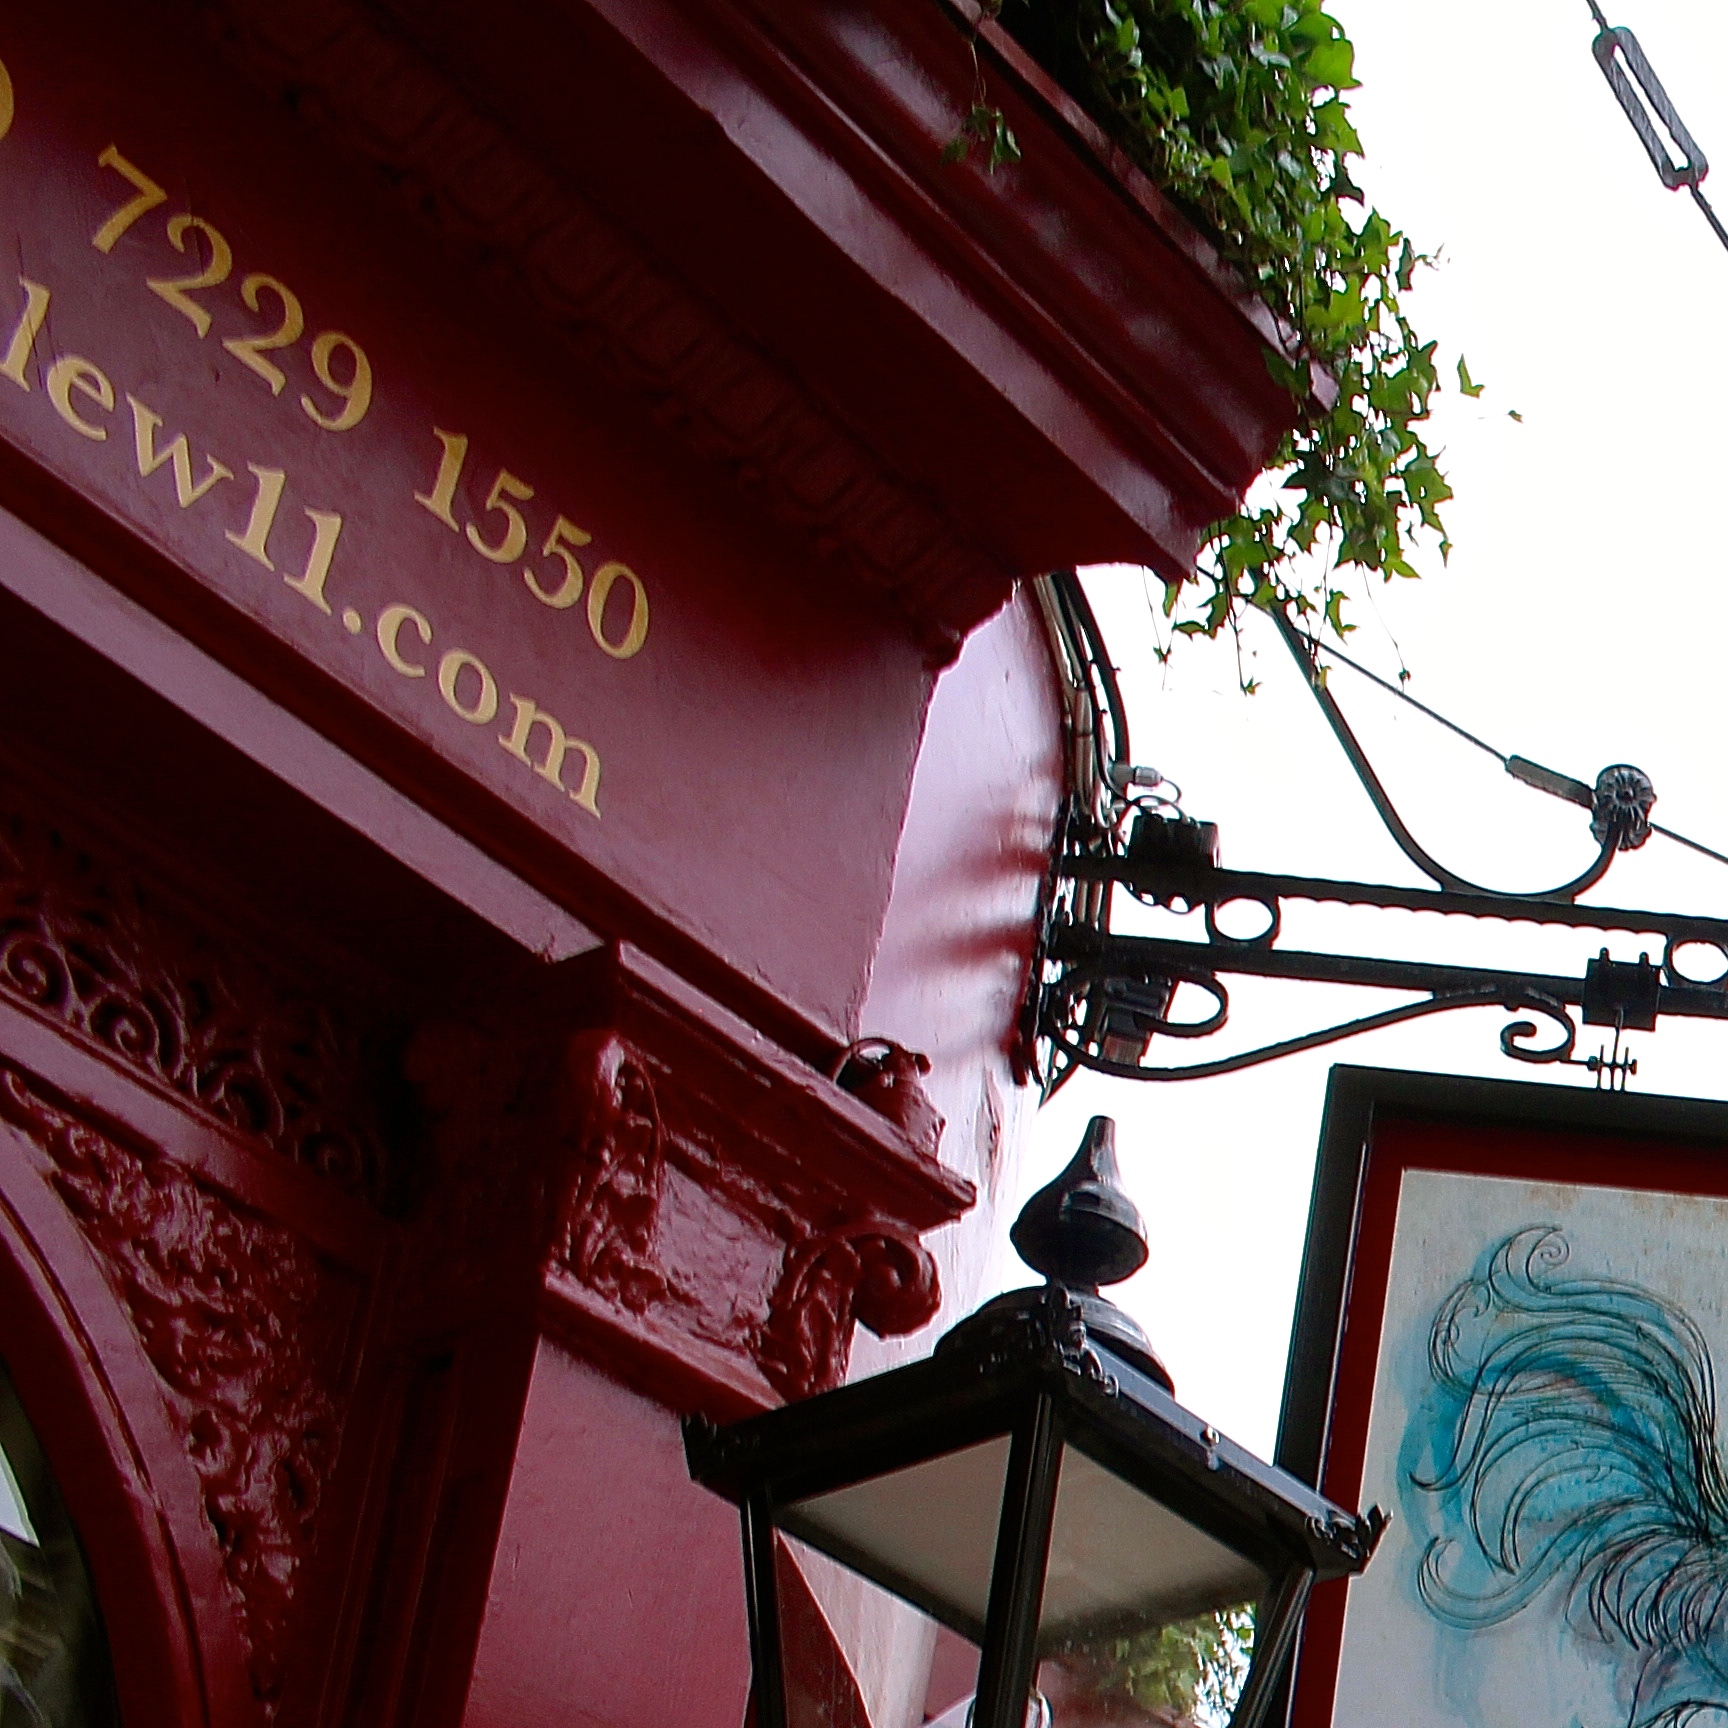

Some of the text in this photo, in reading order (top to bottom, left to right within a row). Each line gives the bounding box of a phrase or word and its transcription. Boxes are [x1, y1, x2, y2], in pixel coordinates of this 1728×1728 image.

[0, 279, 602, 820] lew11.com
[92, 143, 651, 660] 7229 1550
